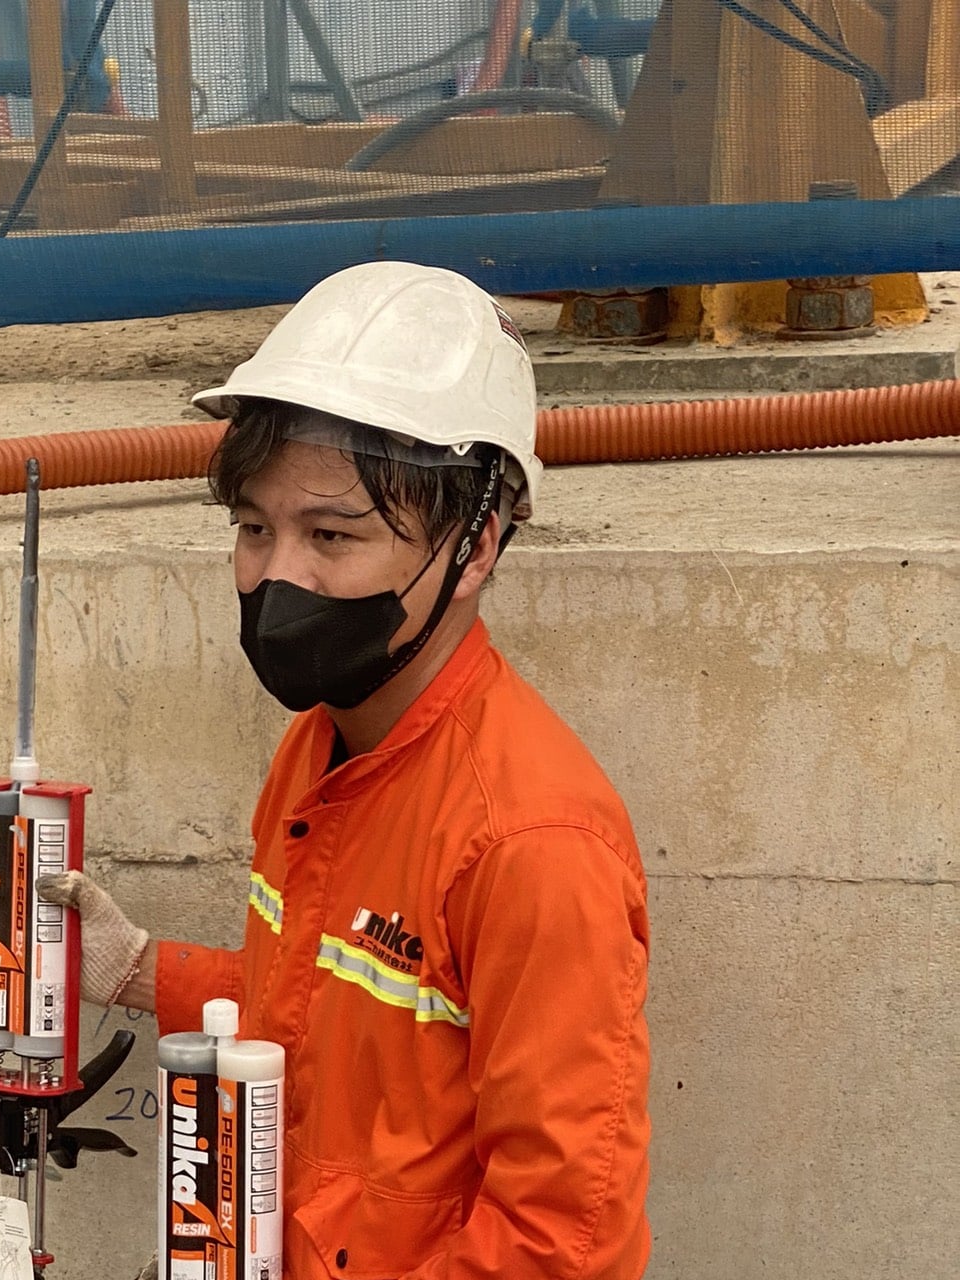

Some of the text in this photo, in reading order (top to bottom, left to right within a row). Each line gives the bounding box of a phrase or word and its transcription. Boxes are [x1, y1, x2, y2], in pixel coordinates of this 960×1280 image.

[172, 1077, 209, 1206] unika
[221, 1116, 233, 1230] PE-600EX
[172, 1222, 212, 1237] RESIN
